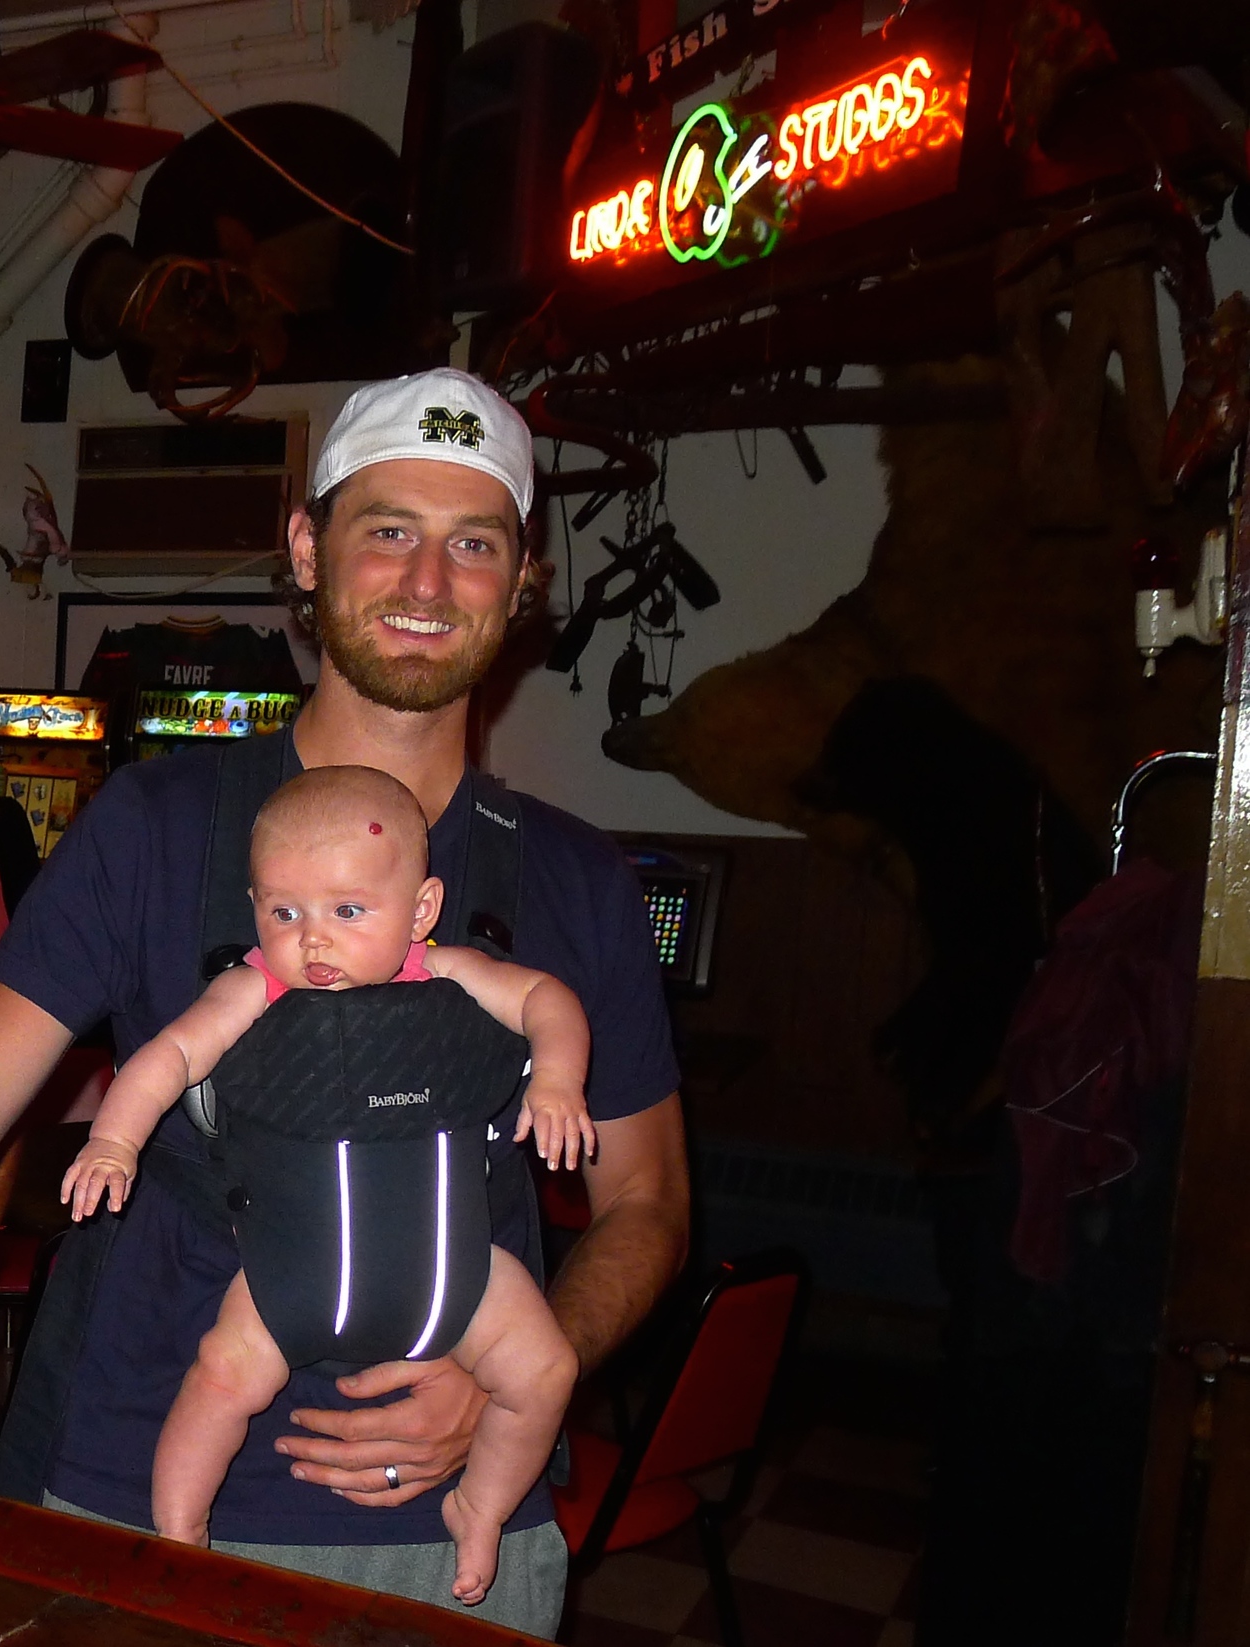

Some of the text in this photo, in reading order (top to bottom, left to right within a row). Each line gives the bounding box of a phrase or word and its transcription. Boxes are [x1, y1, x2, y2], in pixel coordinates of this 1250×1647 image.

[646, 11, 728, 84] Fish
[773, 56, 933, 180] STUBBS
[140, 696, 225, 719] NUDGE
